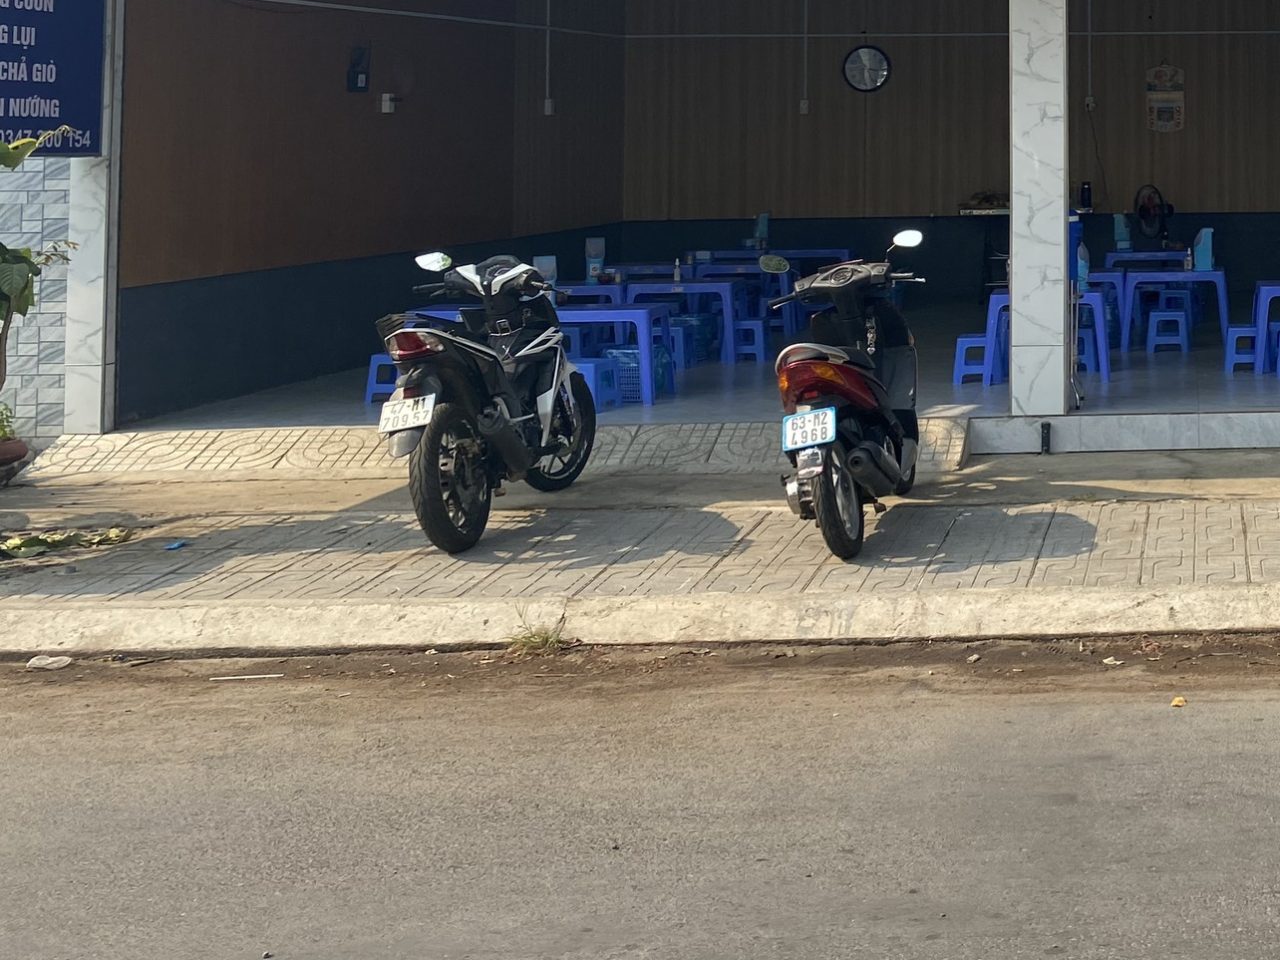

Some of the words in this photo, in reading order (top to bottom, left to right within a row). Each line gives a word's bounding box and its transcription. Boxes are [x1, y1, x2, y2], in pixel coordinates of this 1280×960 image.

[13, 25, 36, 49] LỤI
[0, 56, 28, 81] CHẢ
[32, 60, 57, 83] GIÒ
[9, 95, 60, 118] NƯỚNG
[67, 129, 91, 148] 154
[791, 426, 828, 445] 4968
